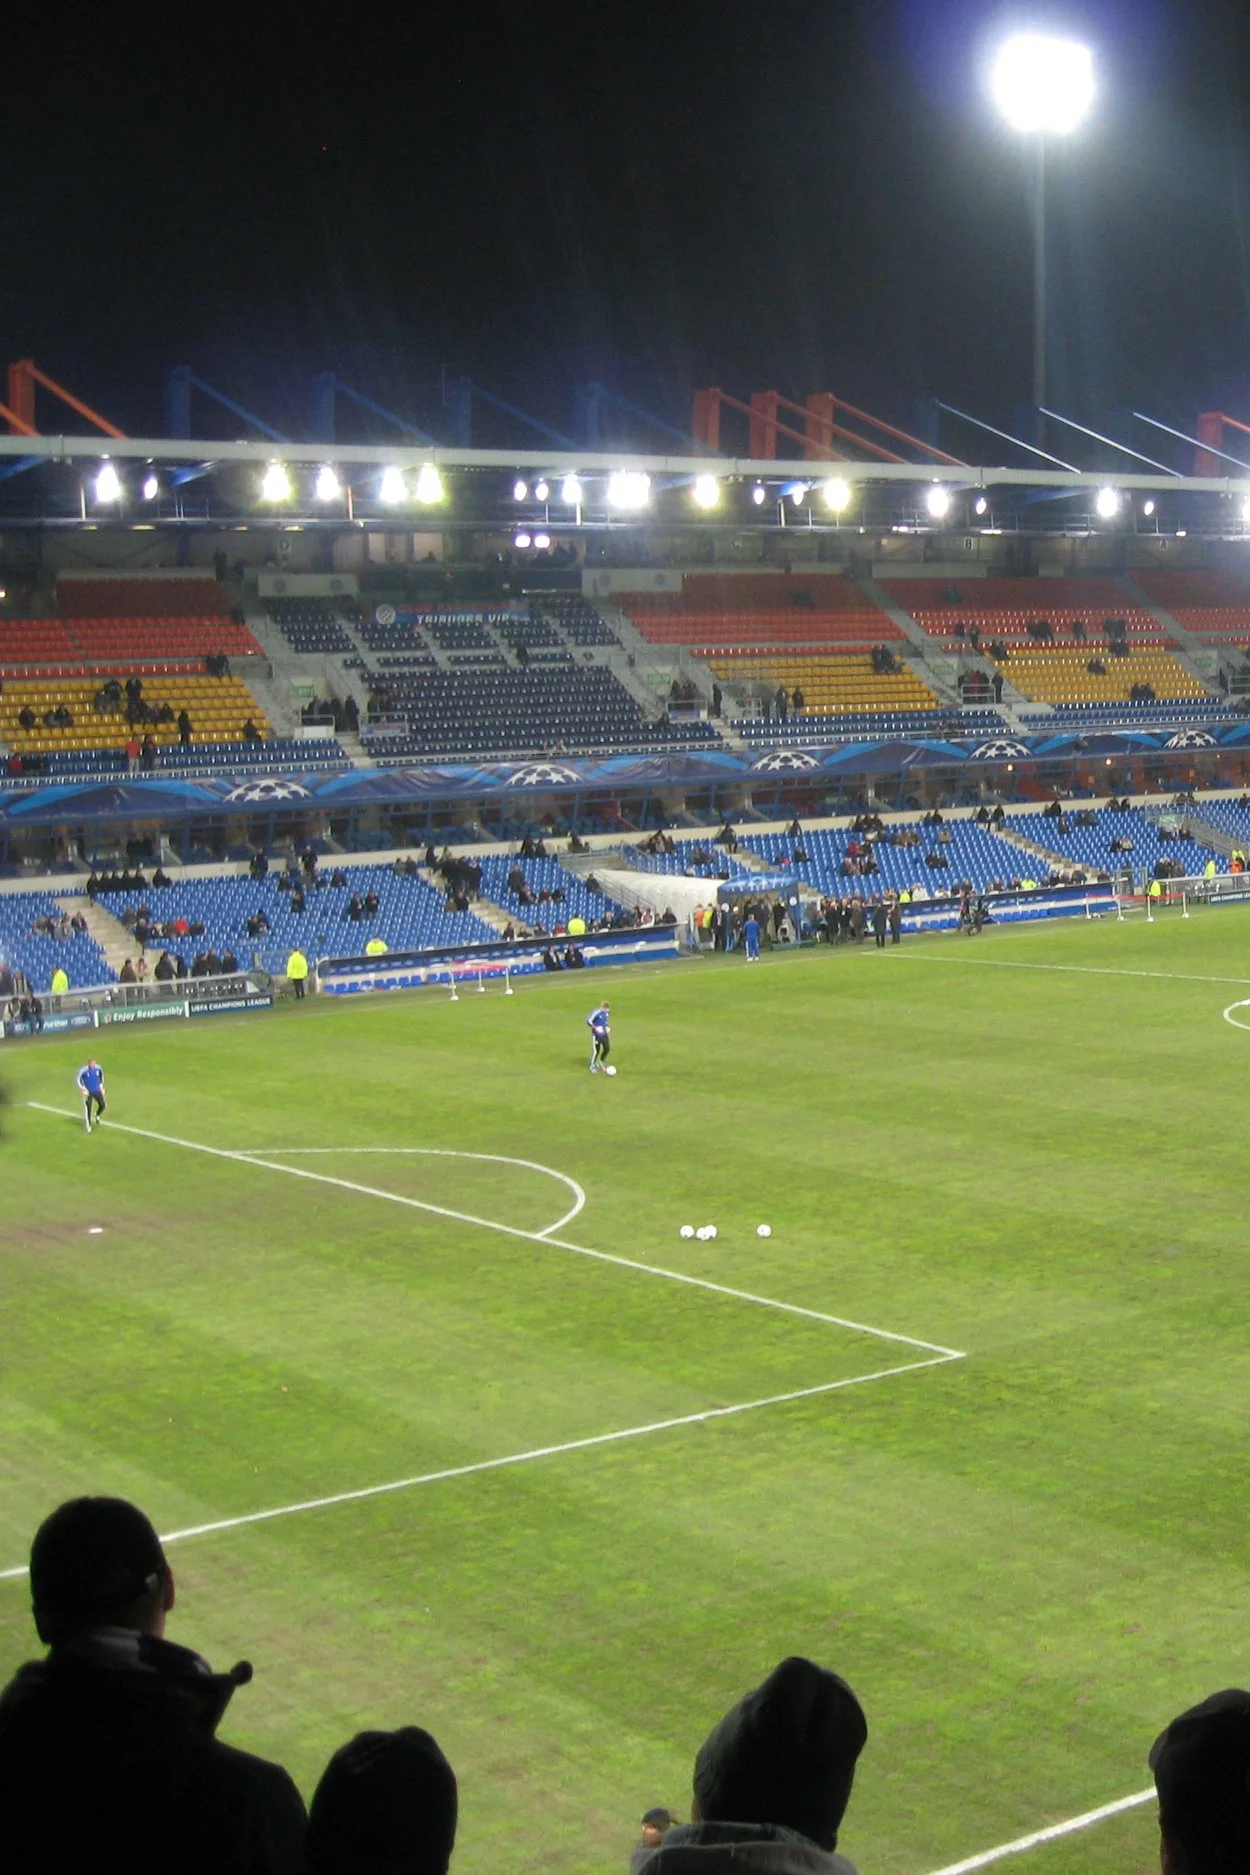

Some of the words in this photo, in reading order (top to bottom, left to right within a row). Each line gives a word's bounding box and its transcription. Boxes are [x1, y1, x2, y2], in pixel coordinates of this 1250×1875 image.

[208, 1000, 246, 1010] CHAMPIONS
[113, 1011, 135, 1022] Enjoy
[136, 1005, 184, 1019] Responsibly
